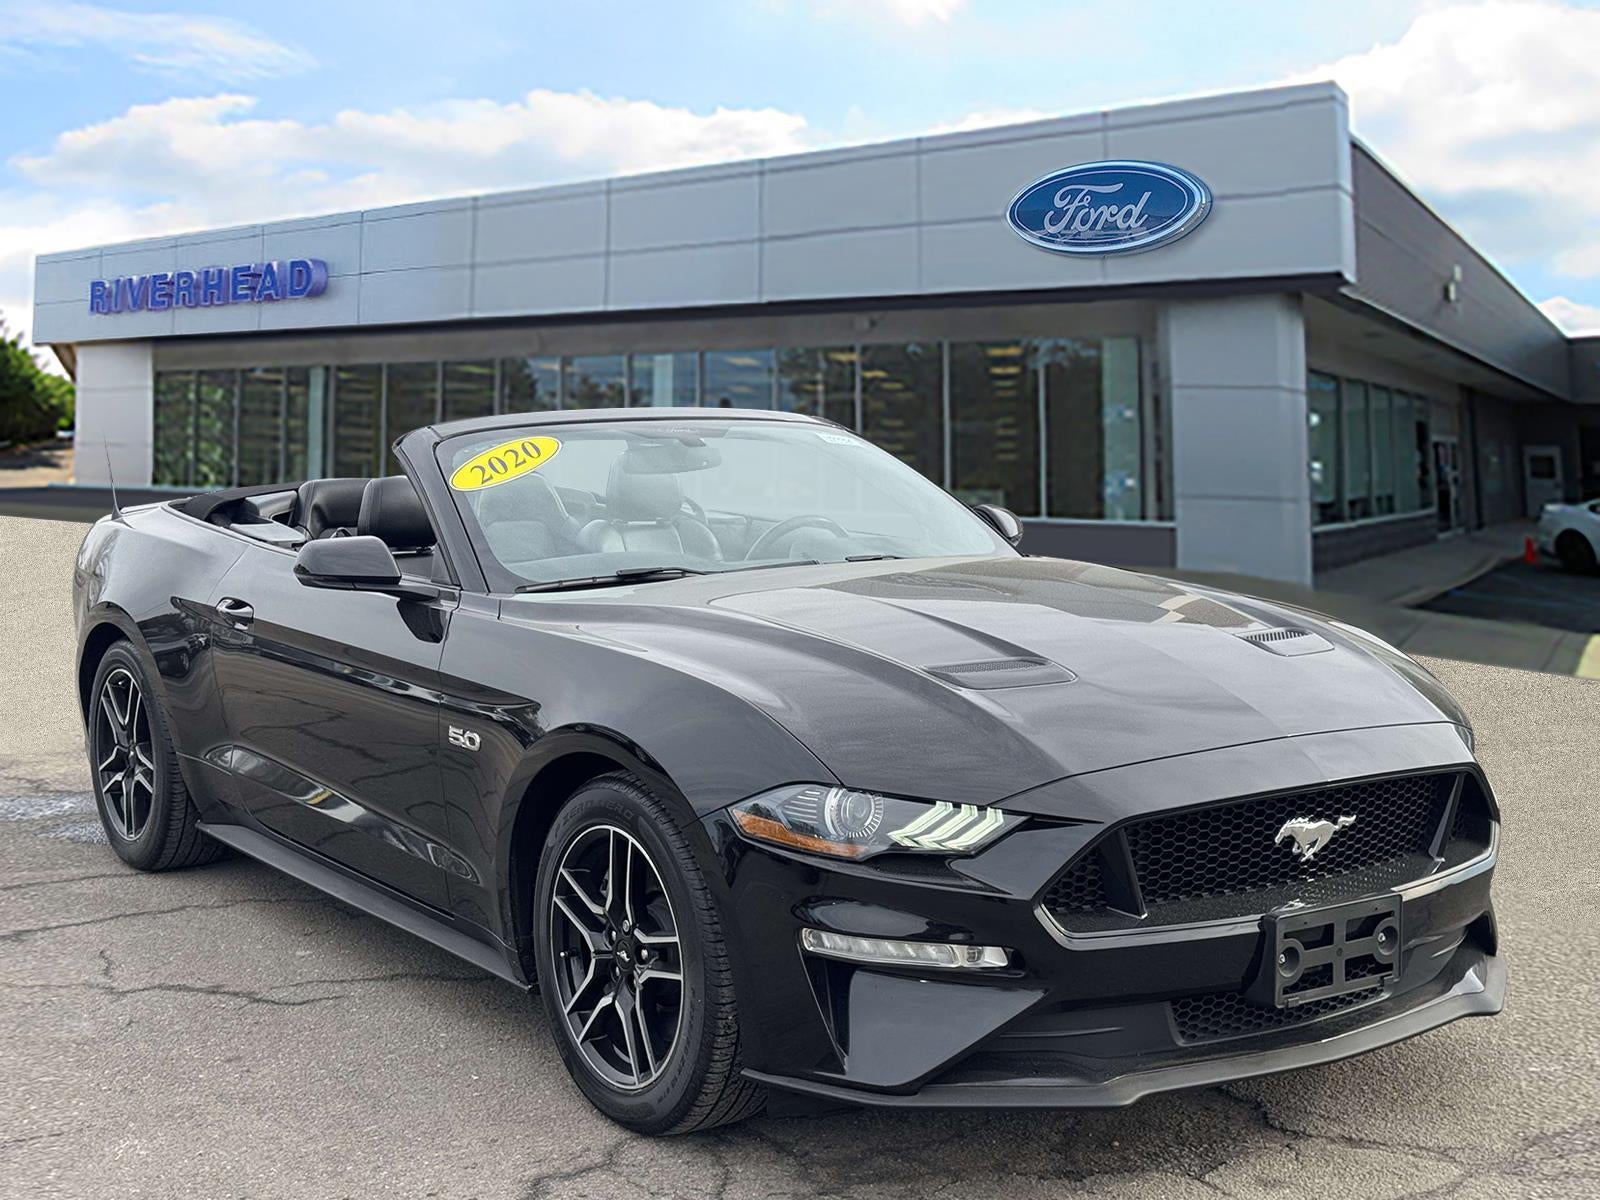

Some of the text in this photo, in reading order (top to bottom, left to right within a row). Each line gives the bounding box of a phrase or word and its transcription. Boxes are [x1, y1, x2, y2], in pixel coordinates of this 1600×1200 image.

[1043, 182, 1152, 234] Ford
[89, 258, 326, 315] RIVERHEAD
[470, 440, 541, 485] 2020
